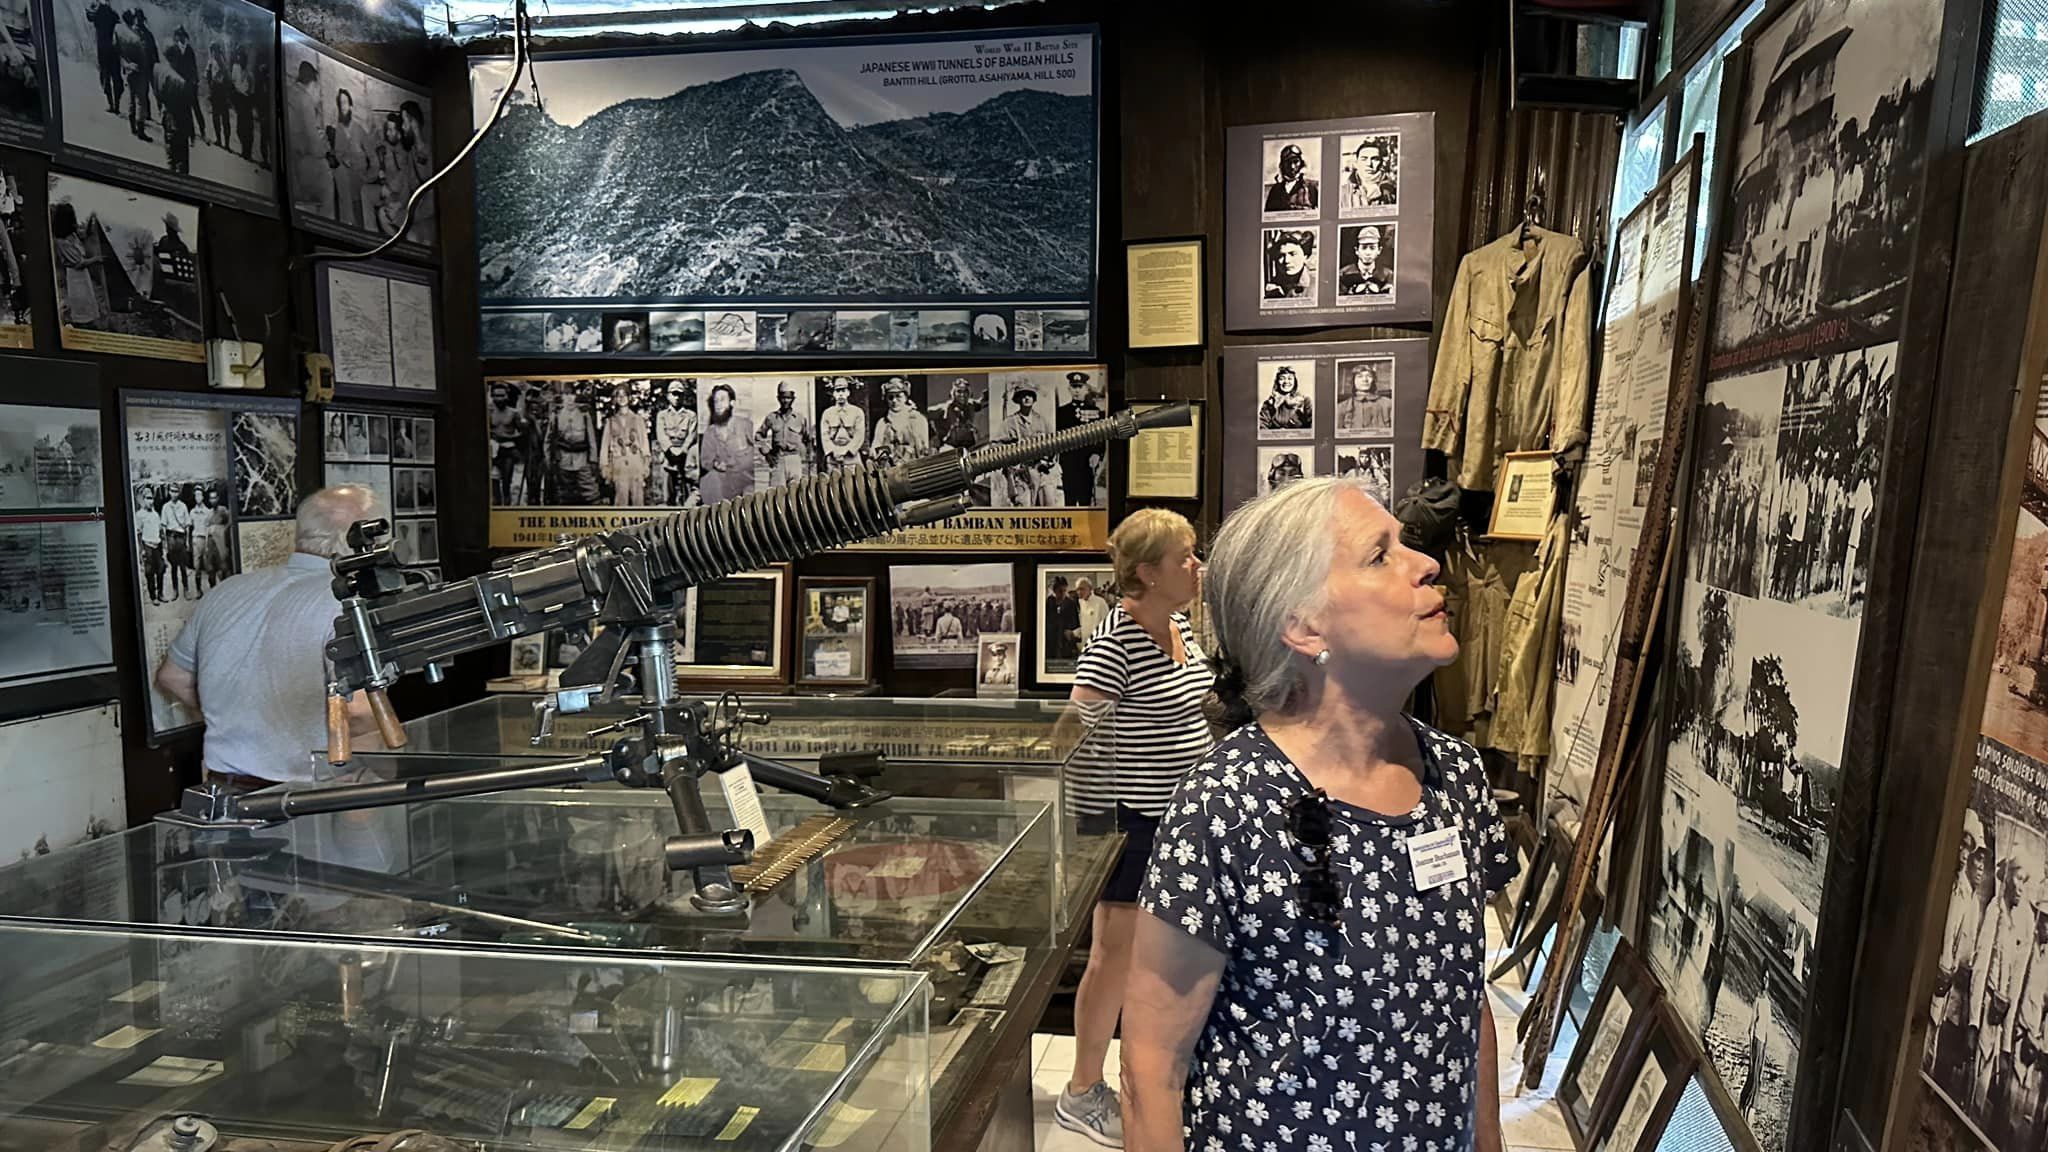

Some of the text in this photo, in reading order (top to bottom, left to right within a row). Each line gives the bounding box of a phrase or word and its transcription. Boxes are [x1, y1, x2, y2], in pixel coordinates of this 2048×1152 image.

[860, 53, 1074, 73] JAPANESE WWII TUNNELS OF BAMBAN HILLS
[918, 76, 938, 85] HILL
[1034, 70, 1054, 80] HILL
[1056, 68, 1076, 79] 500)
[519, 516, 546, 528] THE
[551, 516, 606, 528] BAMBAN
[943, 518, 1004, 529] BAMBAN
[1009, 517, 1073, 529] MUSEUM
[2002, 754, 2036, 782] SOLDIERS
[2026, 792, 2038, 808] OF
